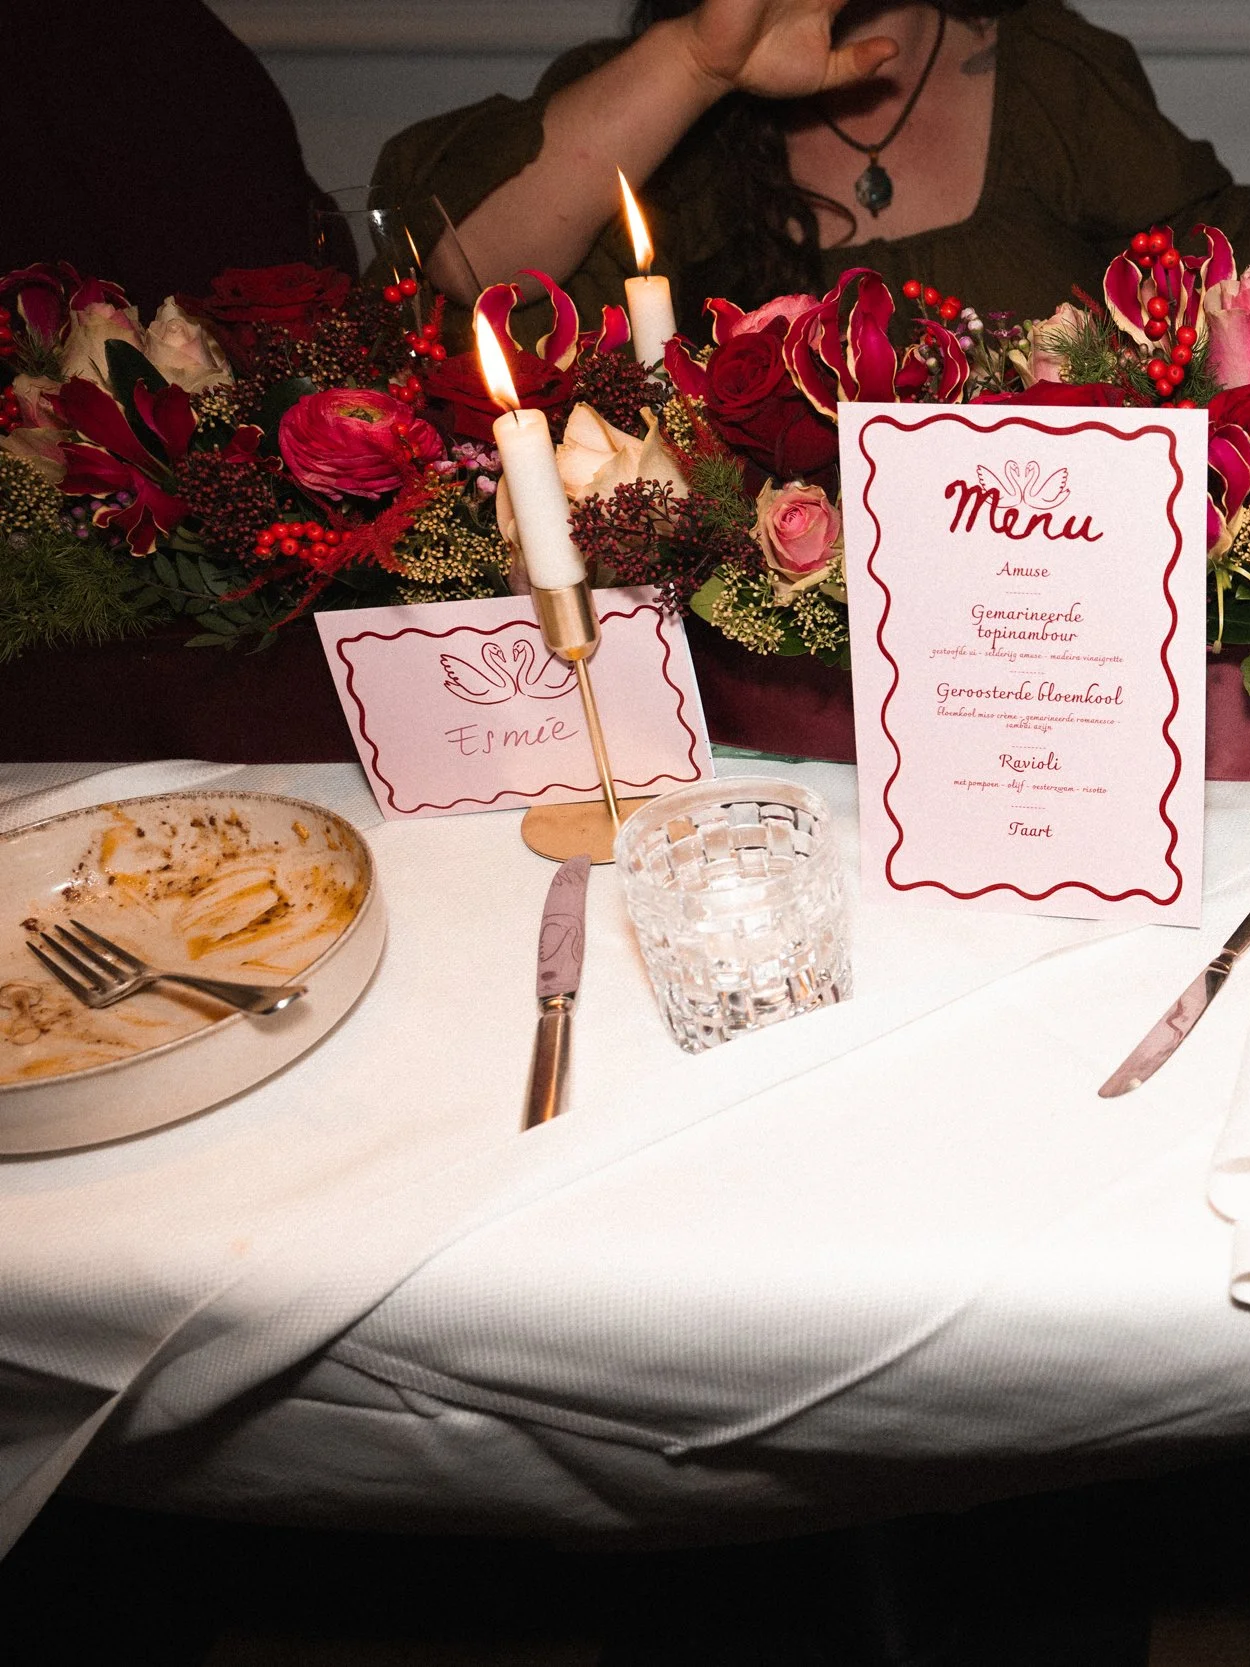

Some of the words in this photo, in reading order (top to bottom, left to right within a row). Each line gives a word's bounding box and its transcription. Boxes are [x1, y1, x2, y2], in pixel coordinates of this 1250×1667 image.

[945, 480, 1103, 542] Menu
[996, 562, 1050, 578] Amuse
[971, 603, 1084, 625] Gemarineerde
[977, 621, 1078, 649] topinambour
[930, 646, 967, 658] gestoofde
[1050, 650, 1081, 661] madeira
[1082, 655, 1124, 666] vinaigrette
[937, 681, 1034, 703] Geroosterde
[1037, 681, 1124, 705] bloemkool
[937, 705, 977, 718] bloemkool
[1025, 713, 1074, 723] gemarineerde
[999, 751, 1061, 773] Ravioli
[967, 780, 999, 791] pompoen
[1007, 779, 1026, 793] olijf
[1082, 786, 1107, 794] risotto
[1008, 822, 1053, 838] Taart
